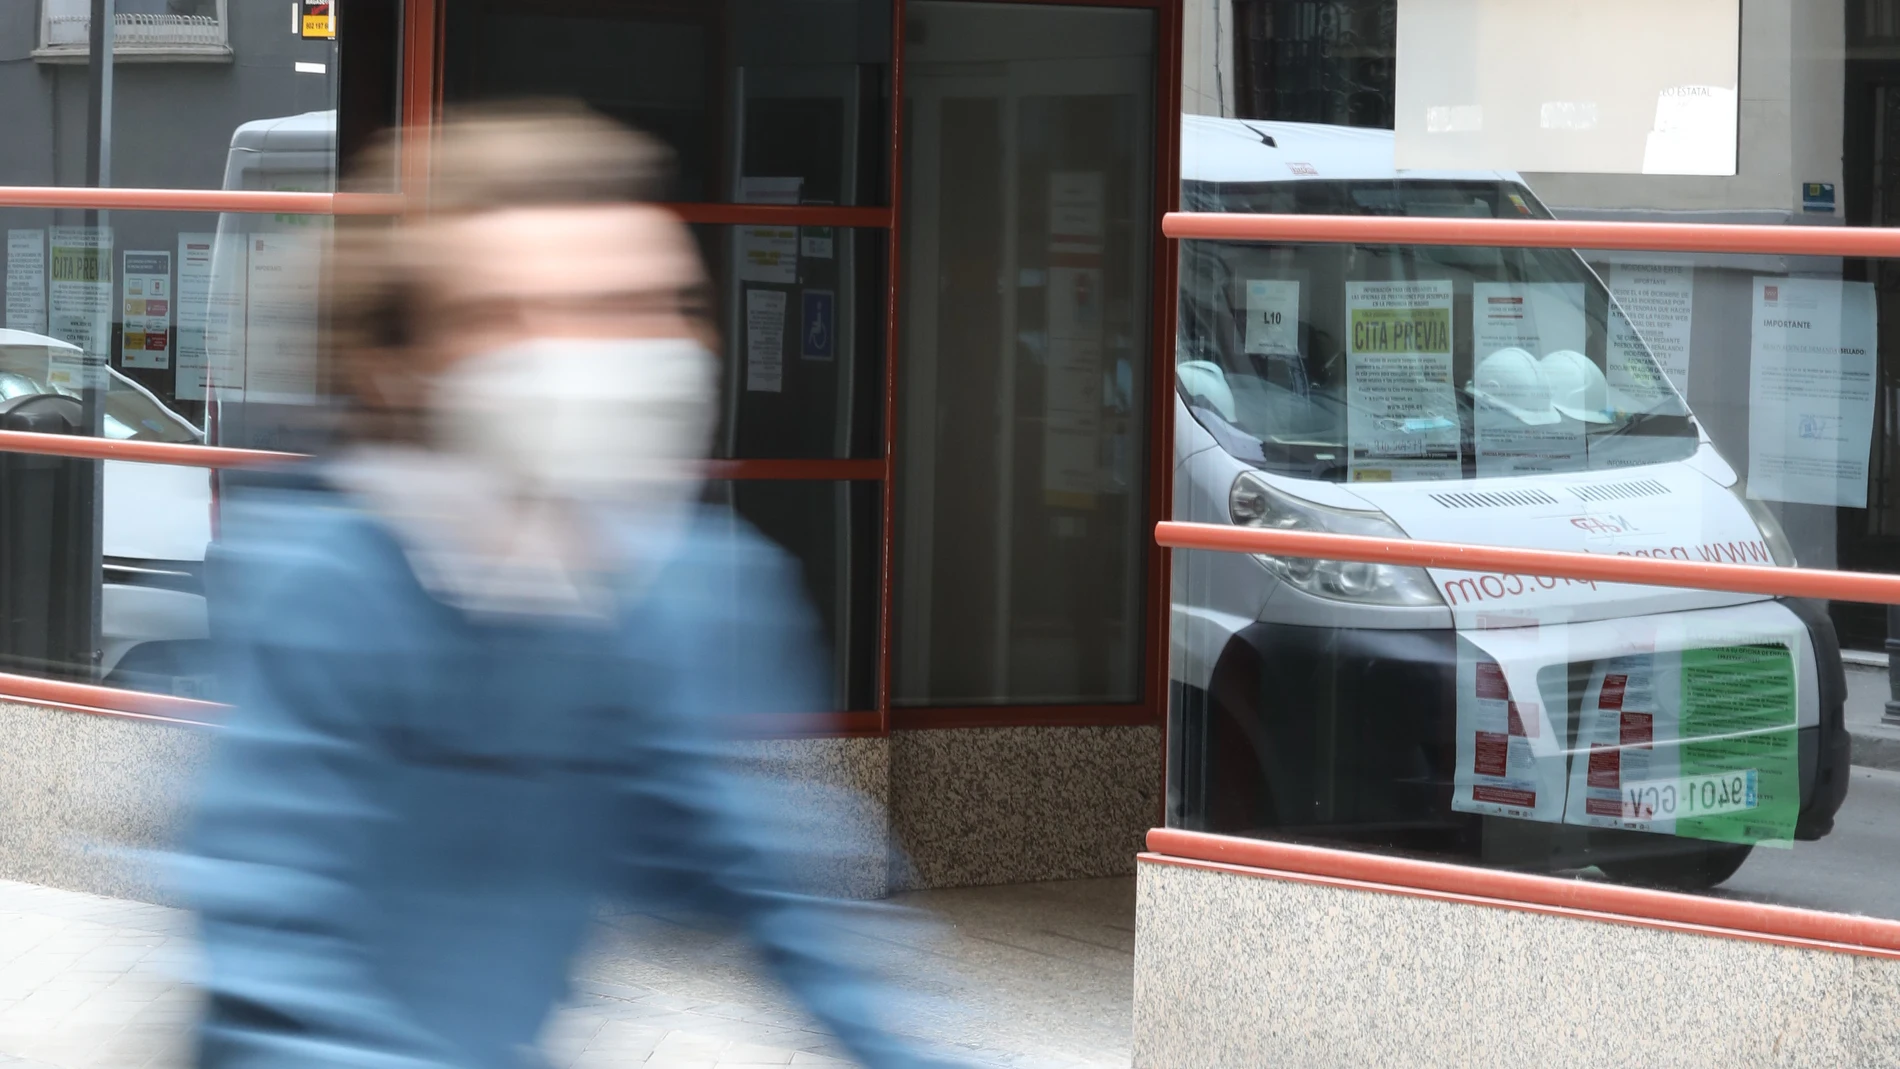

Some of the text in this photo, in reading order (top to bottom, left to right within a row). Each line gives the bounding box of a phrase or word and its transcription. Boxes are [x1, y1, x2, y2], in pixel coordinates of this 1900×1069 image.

[1677, 86, 1712, 97] ESTATAL
[54, 256, 74, 280] CITA
[76, 256, 110, 281] PREVIA
[1264, 312, 1282, 325] L10
[1355, 321, 1449, 351] CITA PREVIA
